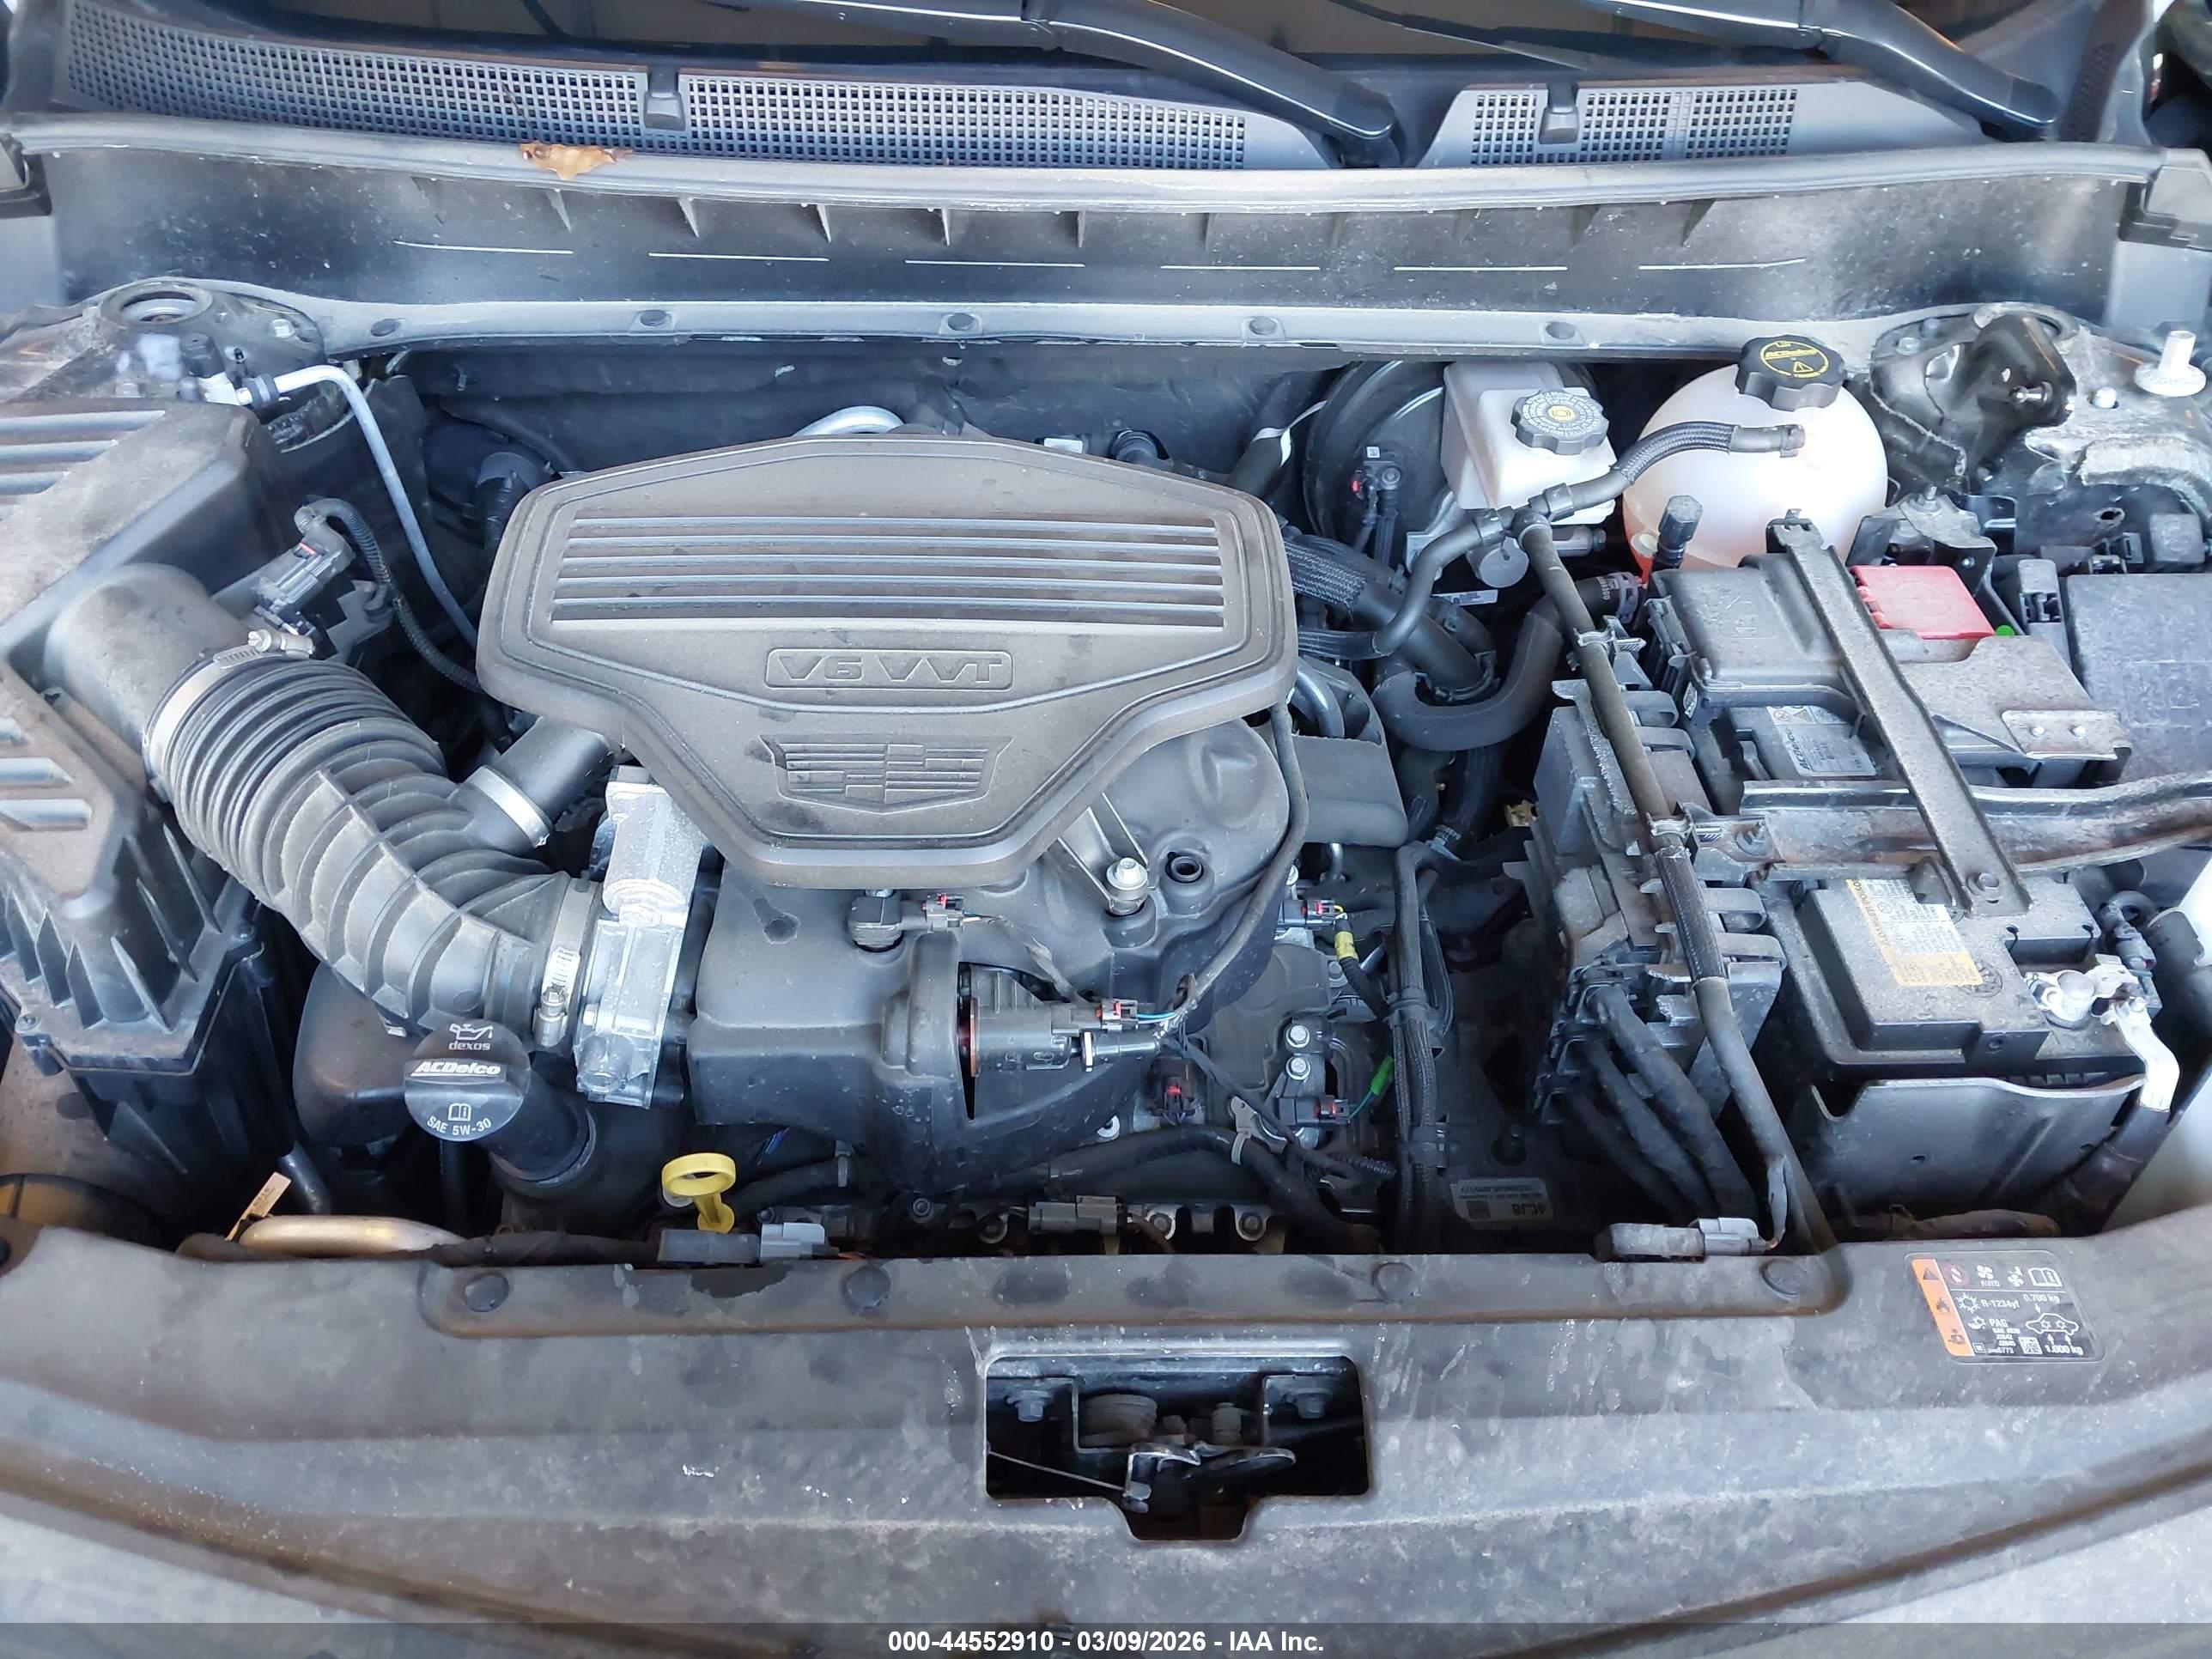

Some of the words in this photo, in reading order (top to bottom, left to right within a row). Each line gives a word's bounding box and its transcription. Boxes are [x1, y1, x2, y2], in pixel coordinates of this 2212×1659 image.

[777, 655, 862, 680] V6
[878, 657, 1003, 684] VVT
[448, 1041, 491, 1051] dexos
[414, 1061, 501, 1075] ACDelco
[427, 1115, 448, 1133] SAE
[452, 1117, 492, 1136] 5W-30
[2047, 1293, 2061, 1304] kg
[1988, 1318, 2008, 1328] PAG
[2045, 1344, 2070, 1354] 1.000
[2069, 1345, 2084, 1356] kg
